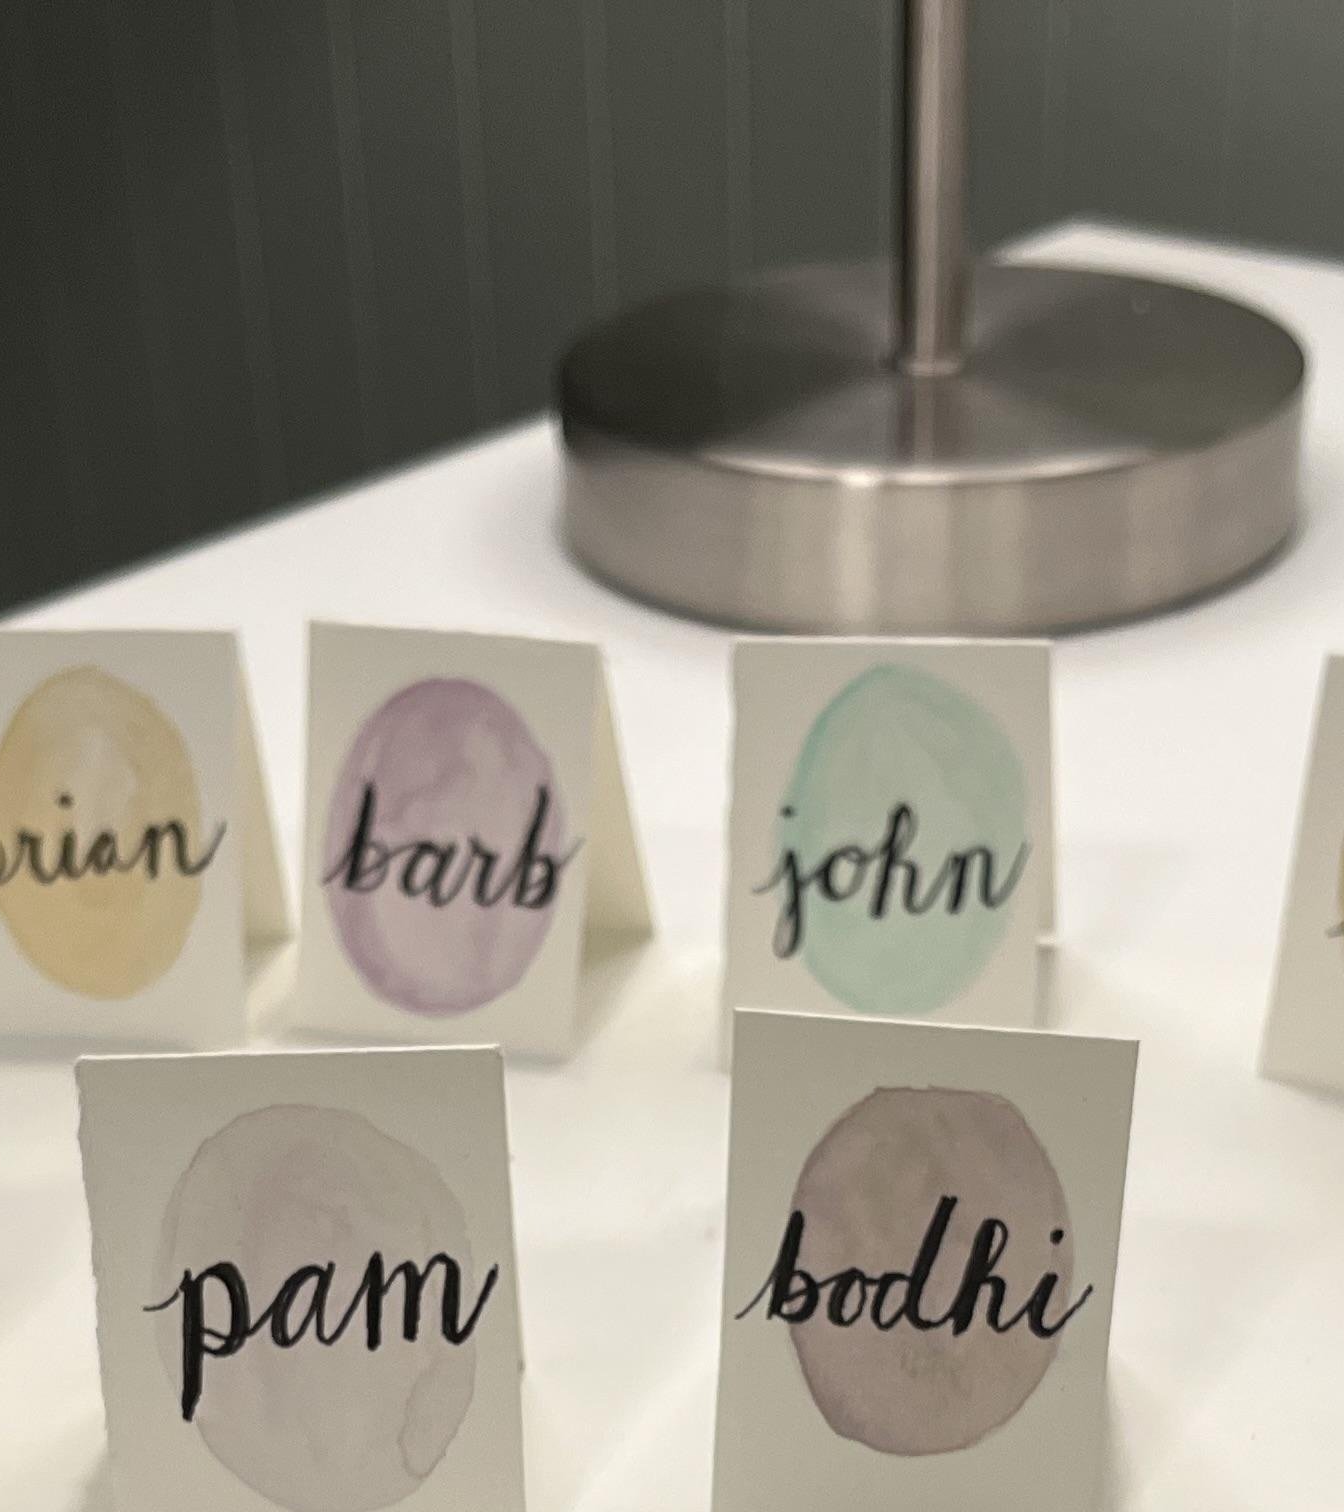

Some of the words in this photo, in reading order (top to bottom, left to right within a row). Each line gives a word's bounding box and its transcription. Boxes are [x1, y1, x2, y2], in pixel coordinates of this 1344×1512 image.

[324, 782, 576, 910] barb
[753, 802, 1030, 957] john
[143, 1250, 500, 1423] pam
[736, 1194, 1094, 1340] bodhi
